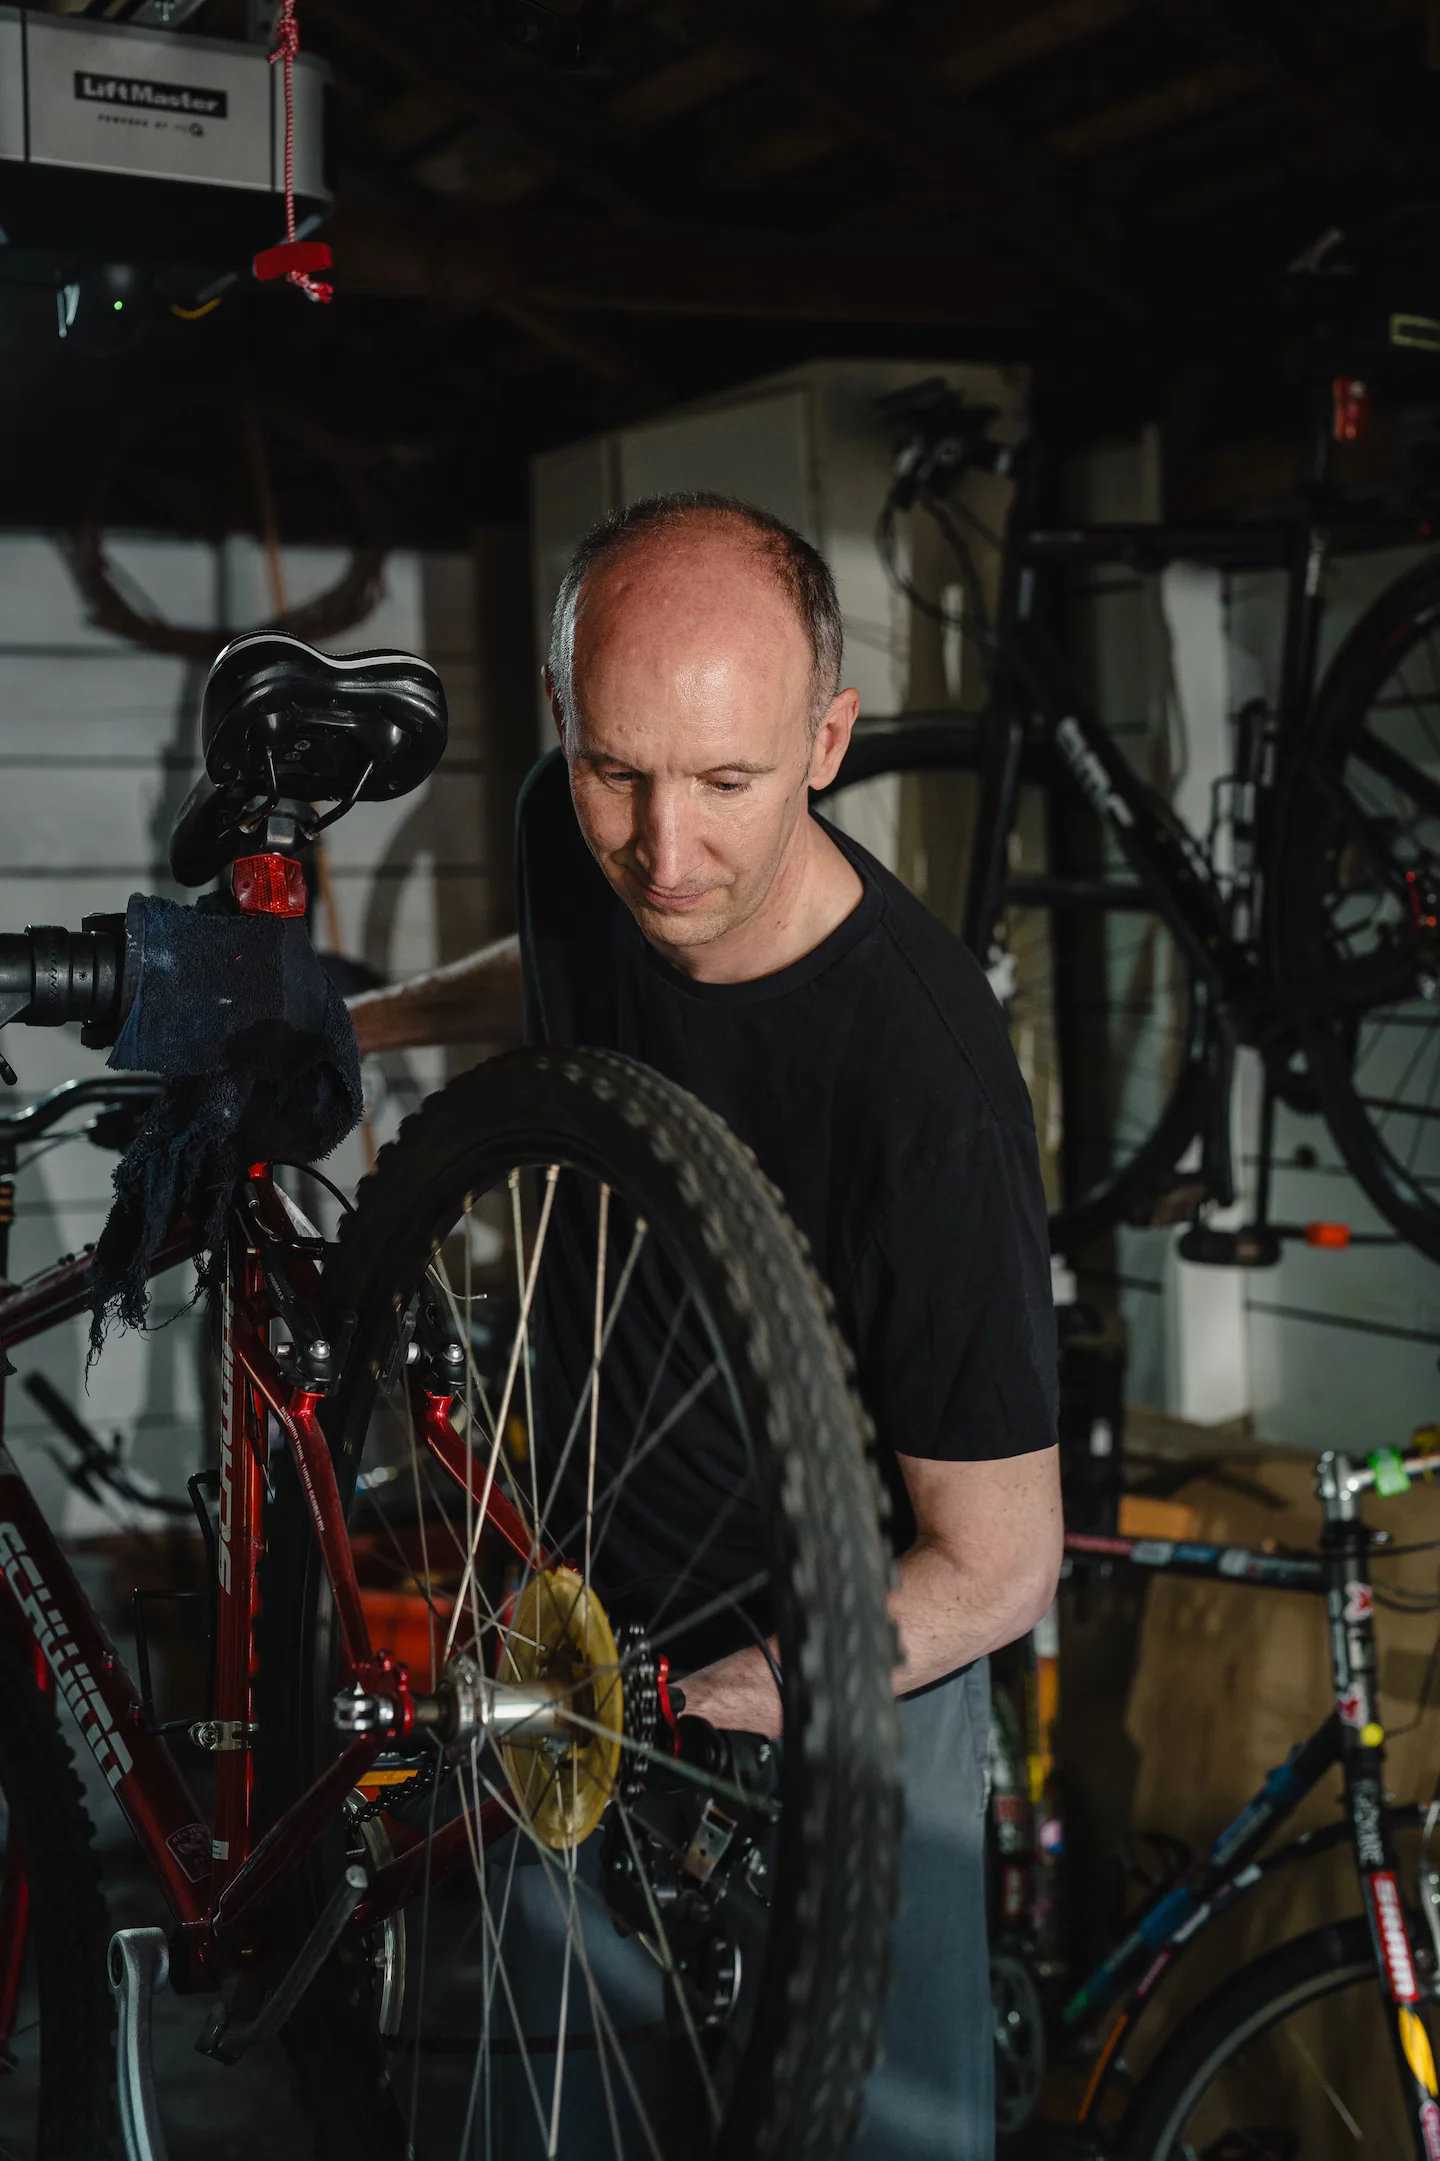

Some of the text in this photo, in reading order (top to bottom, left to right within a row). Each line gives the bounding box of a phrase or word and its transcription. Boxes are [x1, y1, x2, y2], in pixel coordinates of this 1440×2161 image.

[82, 76, 220, 112] LiftMaster
[268, 1272, 285, 1301] PROMAX
[280, 1405, 325, 1532] SCHWINN TRAIL TUNED GEOMETRY
[1373, 1877, 1418, 1998] SRAM
